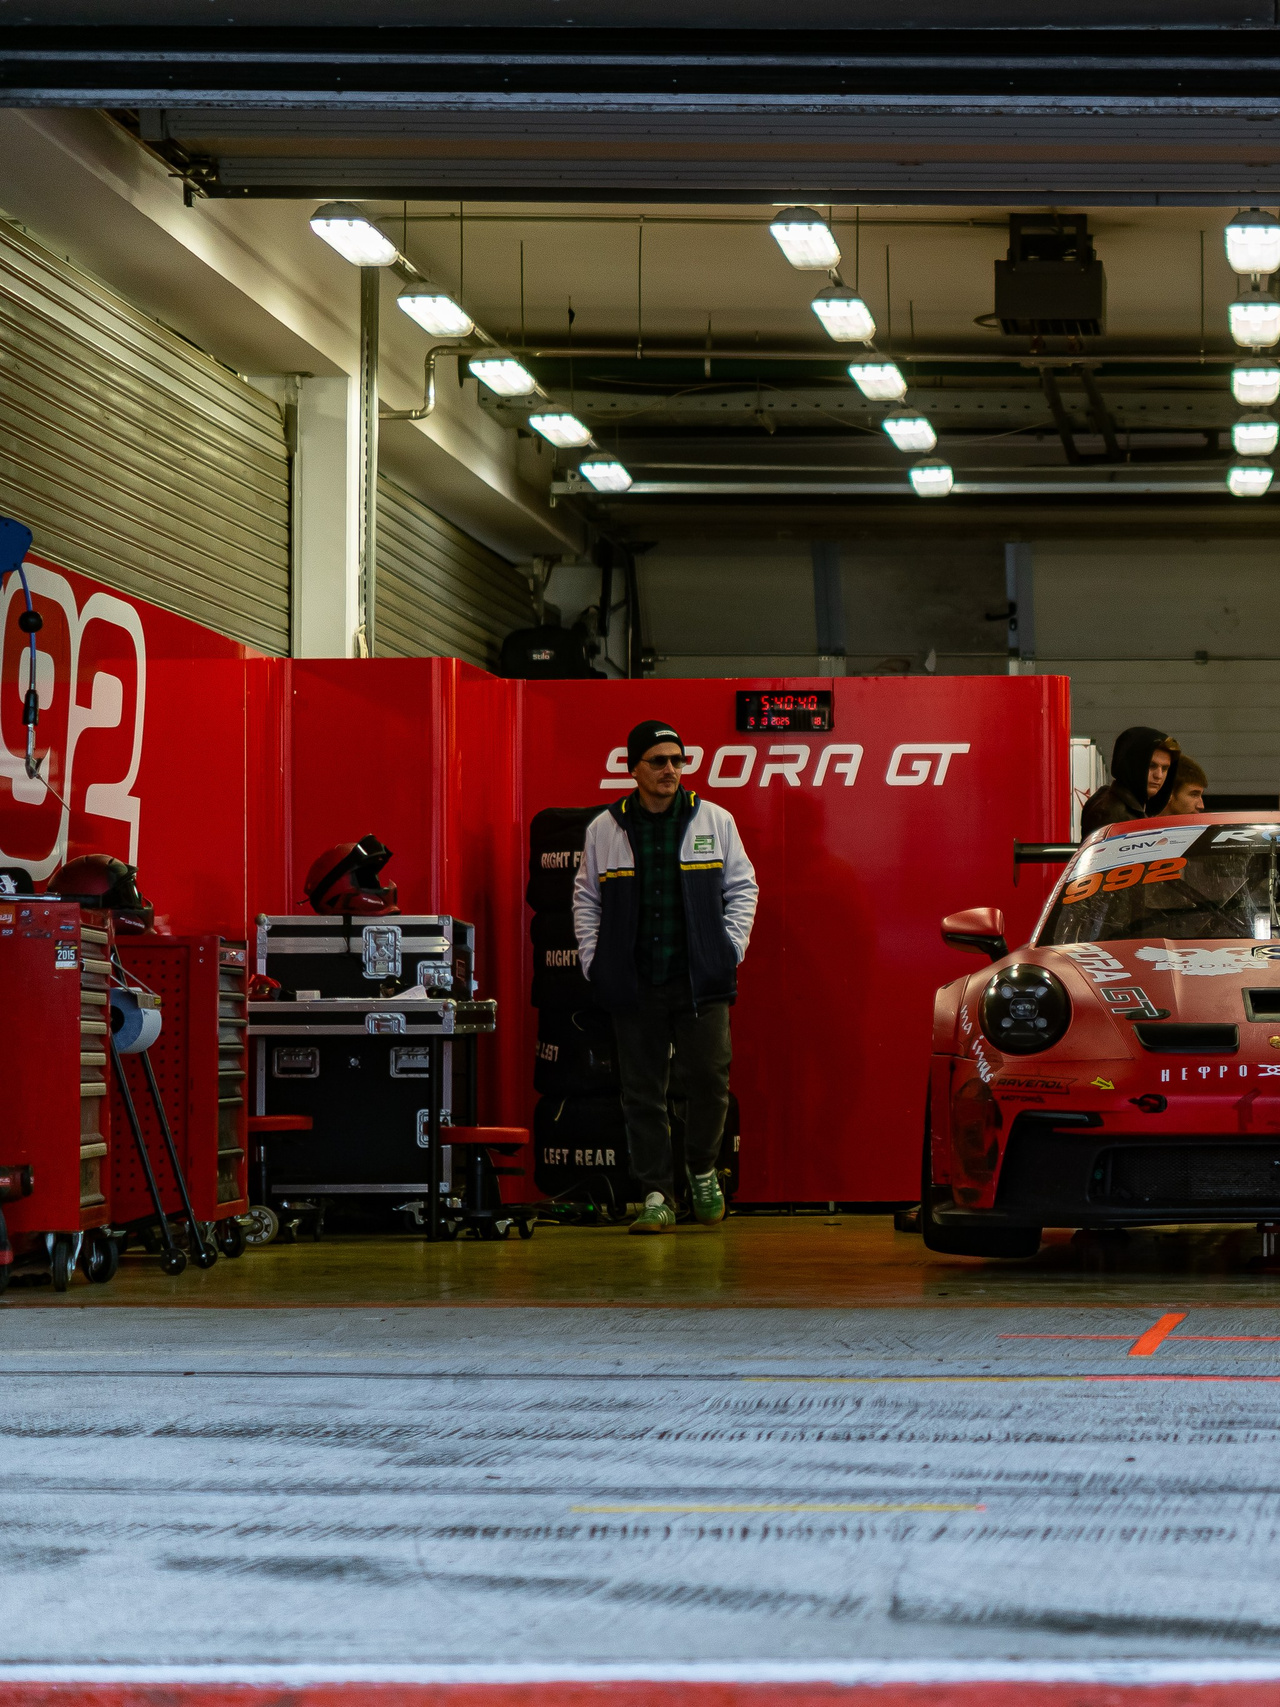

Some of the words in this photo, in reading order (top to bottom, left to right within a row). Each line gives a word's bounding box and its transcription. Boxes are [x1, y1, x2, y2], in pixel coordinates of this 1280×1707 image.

[761, 695, 818, 711] 5:40:40
[886, 743, 970, 787] GT
[1118, 839, 1157, 852] GNV
[541, 850, 570, 869] RIGHT
[1062, 857, 1188, 905] 992
[546, 950, 579, 968] RIGHT
[1100, 986, 1160, 1017] GT
[1161, 1064, 1248, 1082] НЕФРО
[543, 1148, 569, 1166] LEFT
[575, 1148, 616, 1166] REAR
